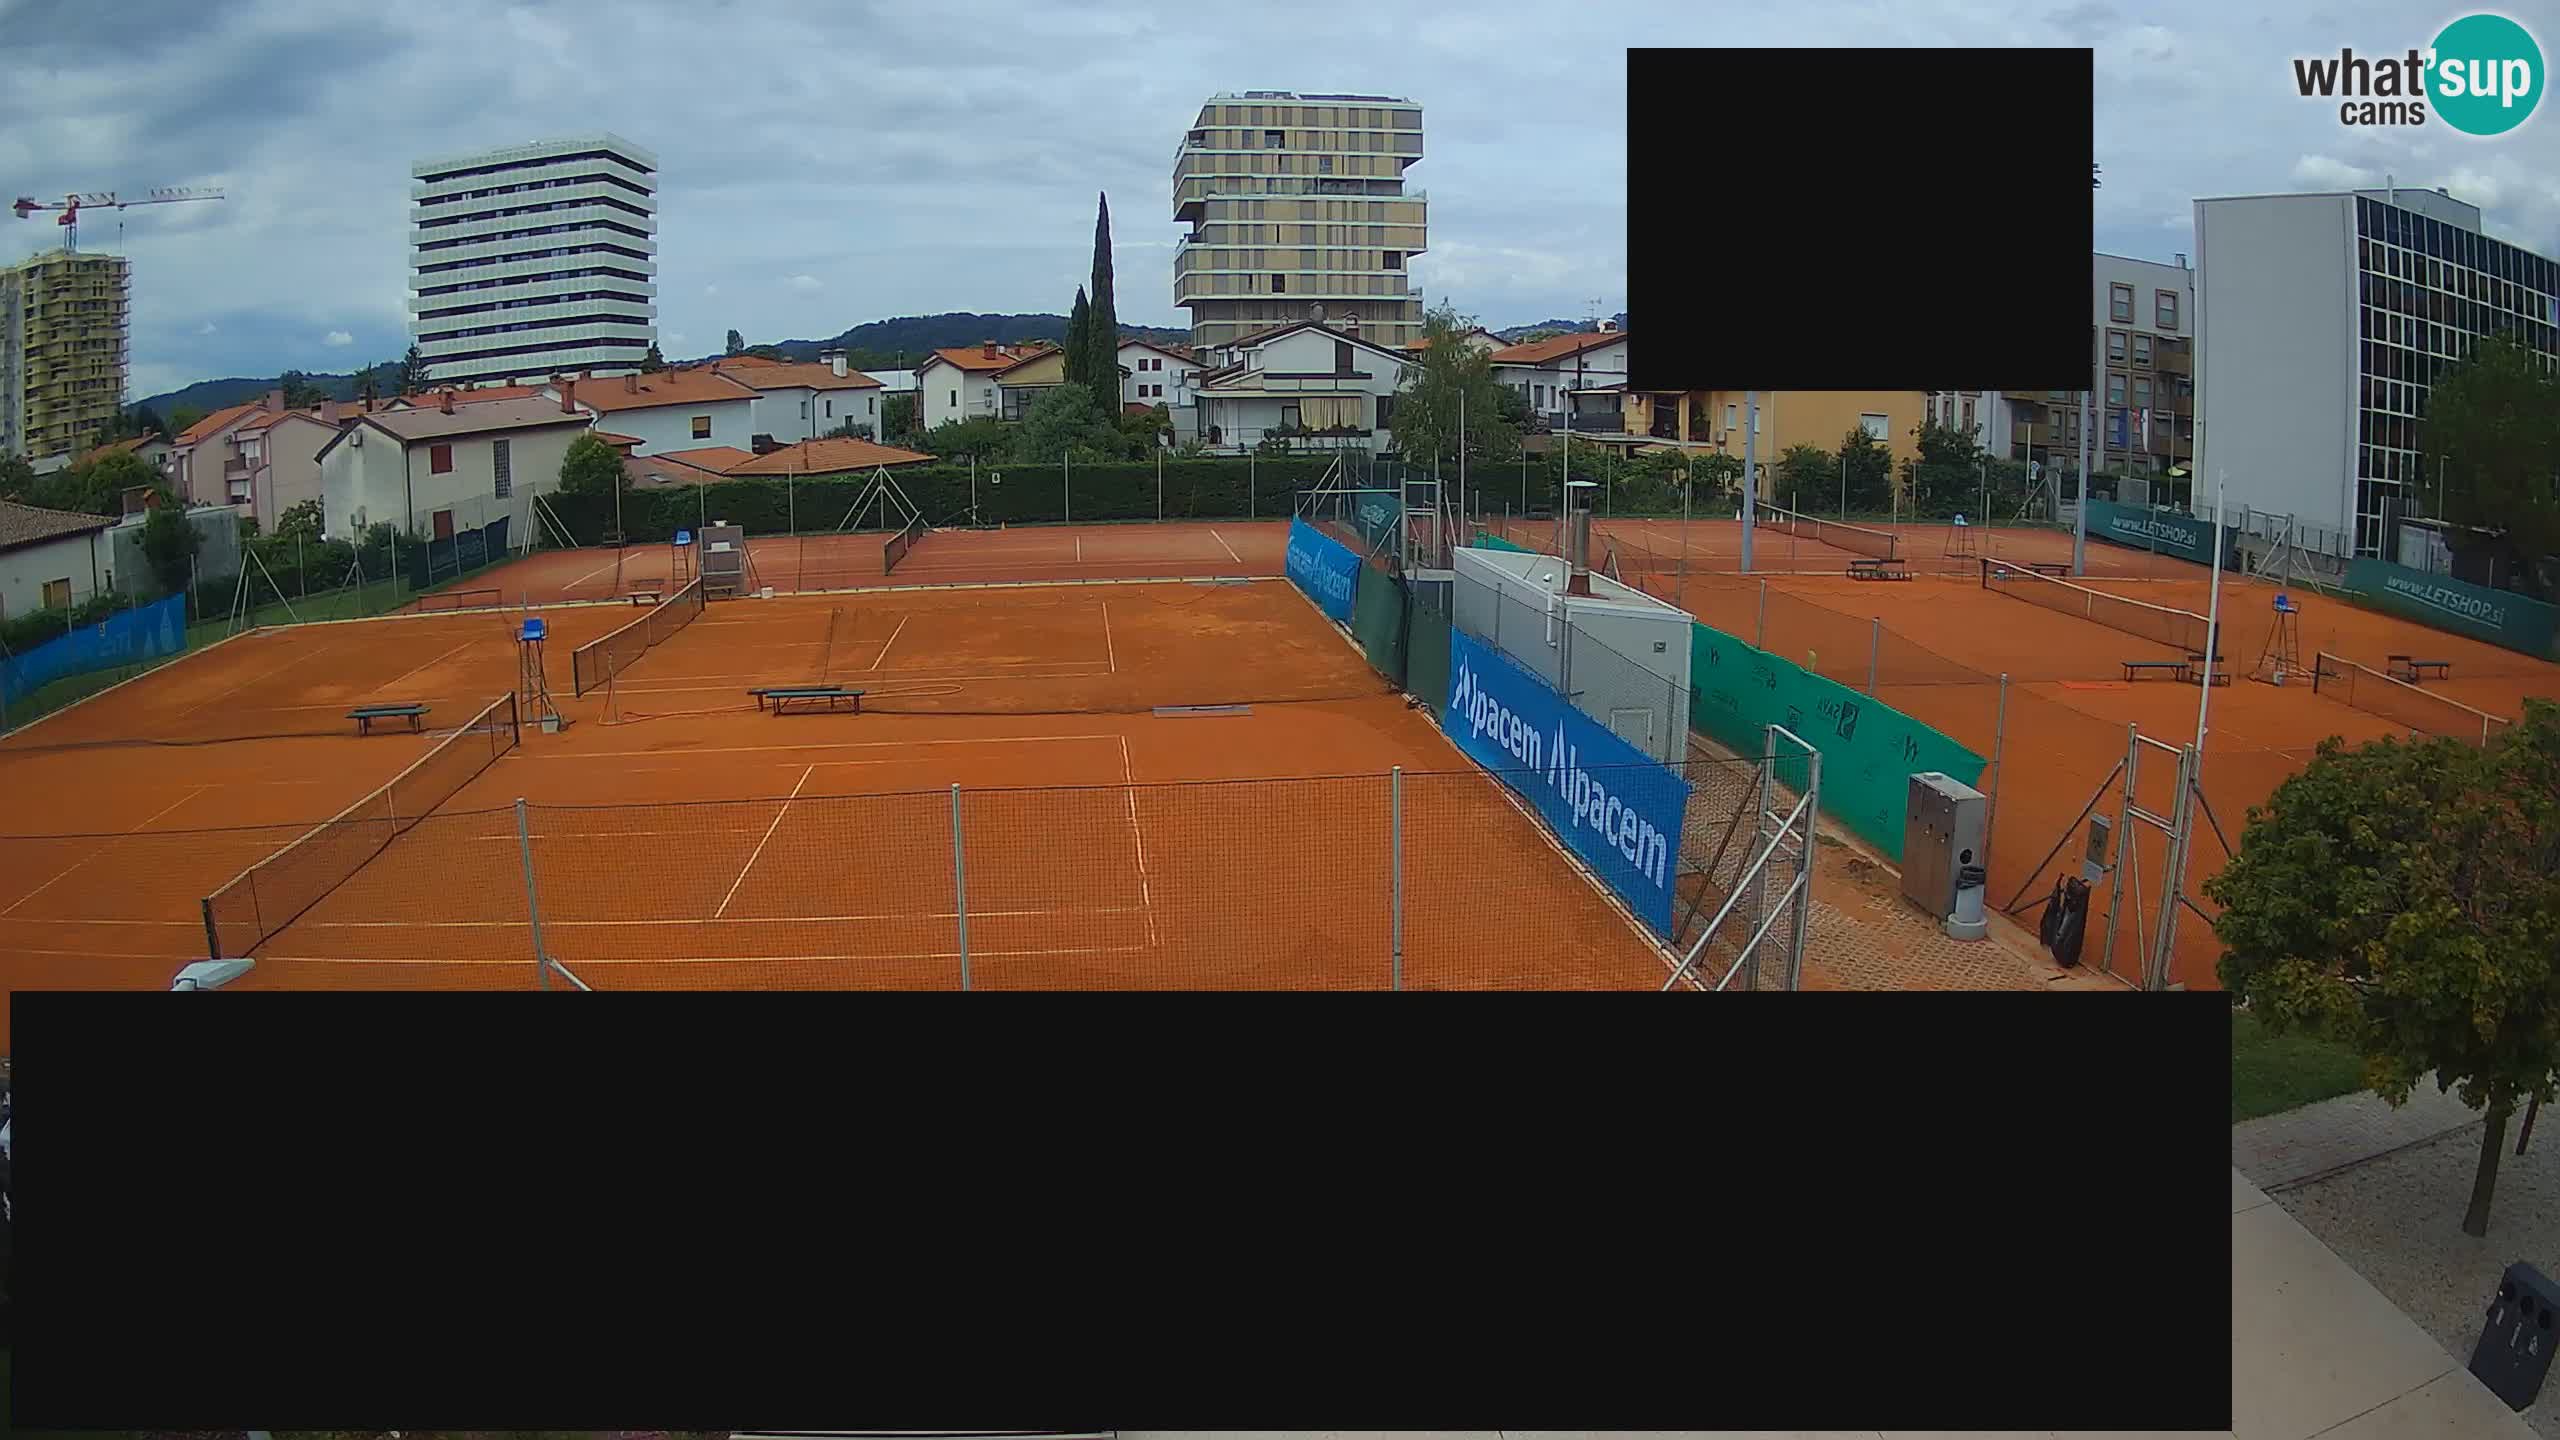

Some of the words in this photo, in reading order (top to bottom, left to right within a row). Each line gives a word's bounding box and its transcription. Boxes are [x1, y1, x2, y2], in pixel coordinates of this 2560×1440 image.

[2112, 515, 2197, 546] www.LETSHOP.si
[2387, 575, 2506, 625] www.LETSHOP.si
[1452, 653, 1541, 774] Alpacem
[1547, 718, 1667, 889] Alpacem
